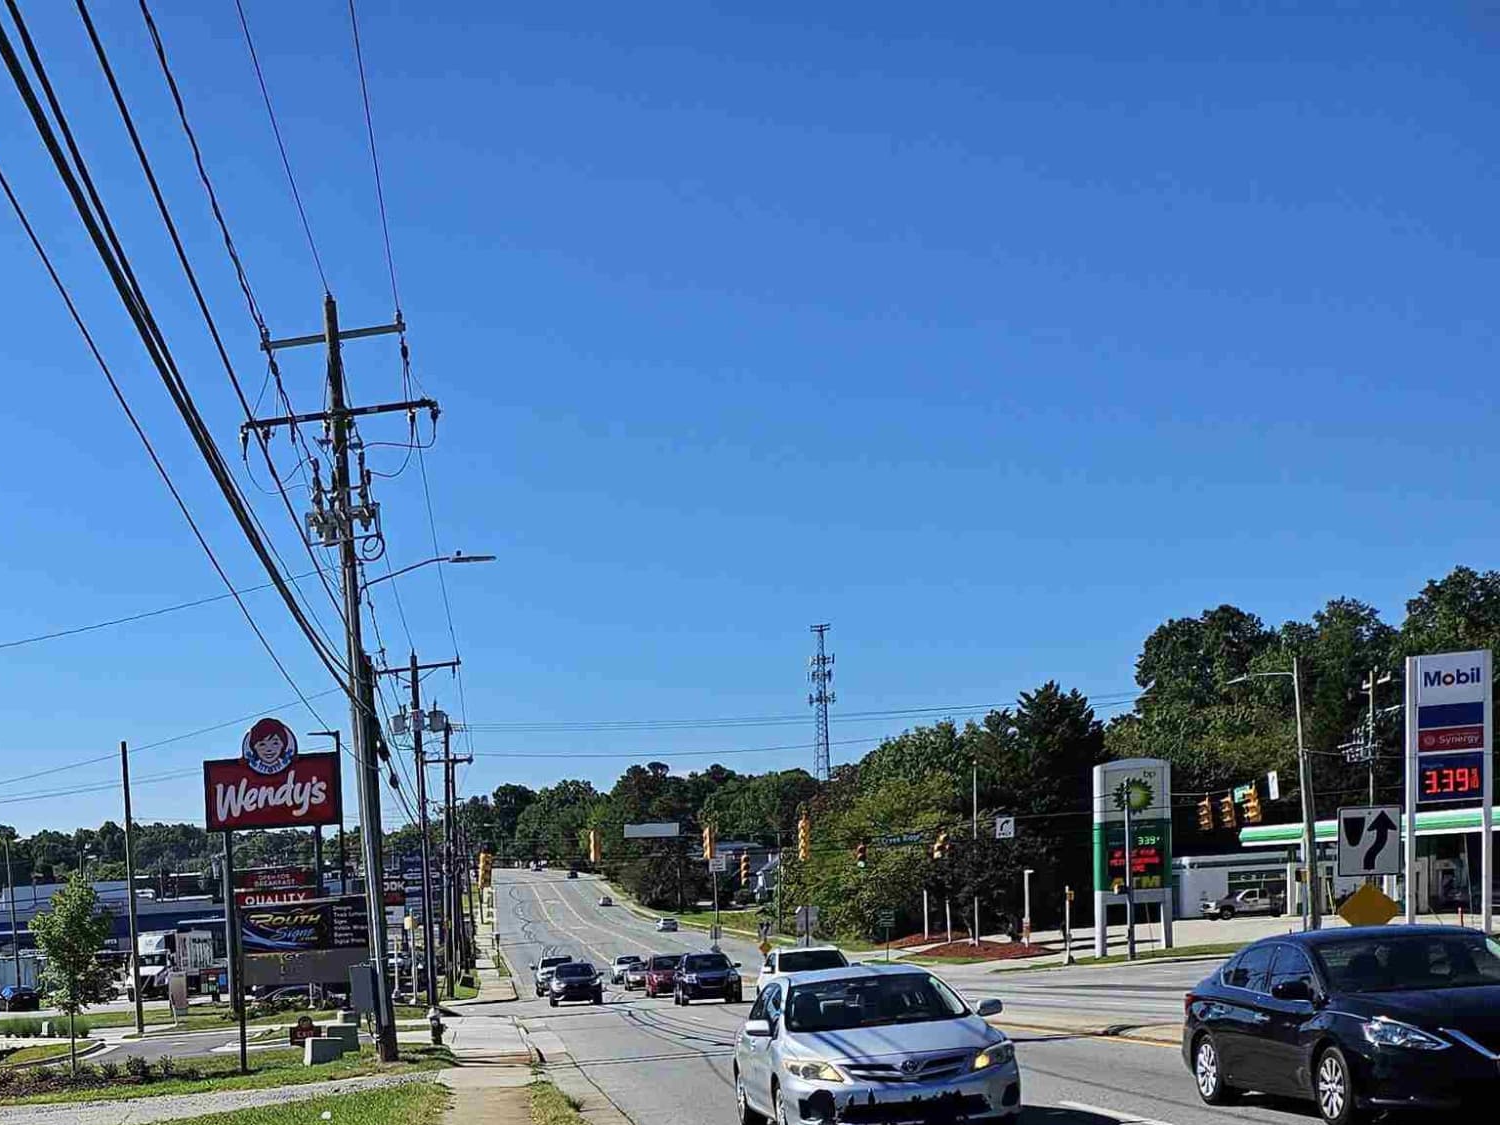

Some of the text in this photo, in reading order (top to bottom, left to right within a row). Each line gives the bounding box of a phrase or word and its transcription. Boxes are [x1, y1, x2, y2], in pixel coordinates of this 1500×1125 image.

[1423, 667, 1481, 688] Mobil
[1438, 734, 1480, 746] Synergy
[1143, 770, 1156, 779] bp
[1424, 768, 1469, 794] 3.39
[215, 770, 327, 821] Wendy's
[244, 892, 306, 905] QUALITY
